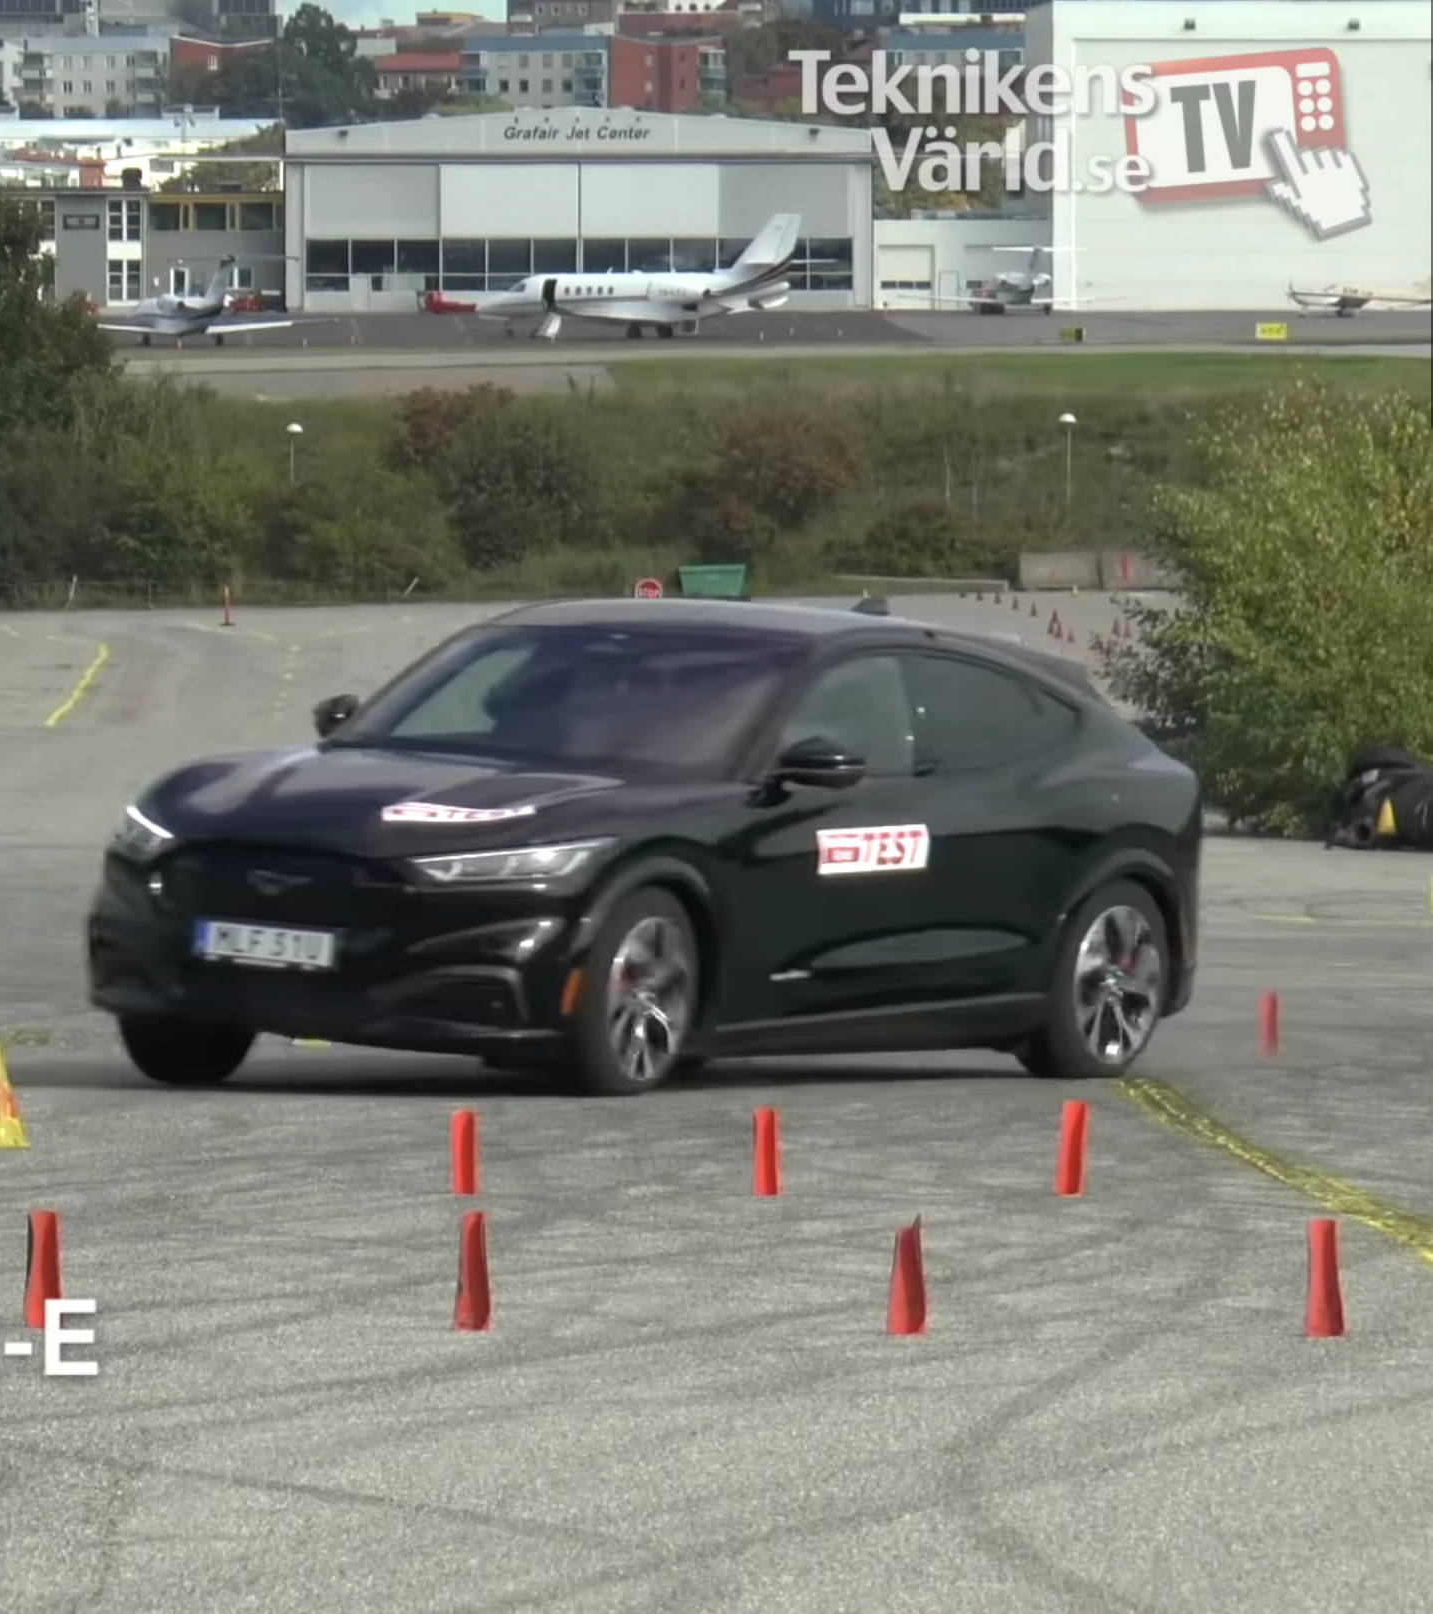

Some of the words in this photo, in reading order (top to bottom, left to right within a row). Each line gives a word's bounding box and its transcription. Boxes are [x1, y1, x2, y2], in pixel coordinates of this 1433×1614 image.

[503, 125, 560, 141] Grafair
[565, 125, 591, 141] Jet
[596, 125, 650, 141] Center
[861, 829, 923, 866] TEST
